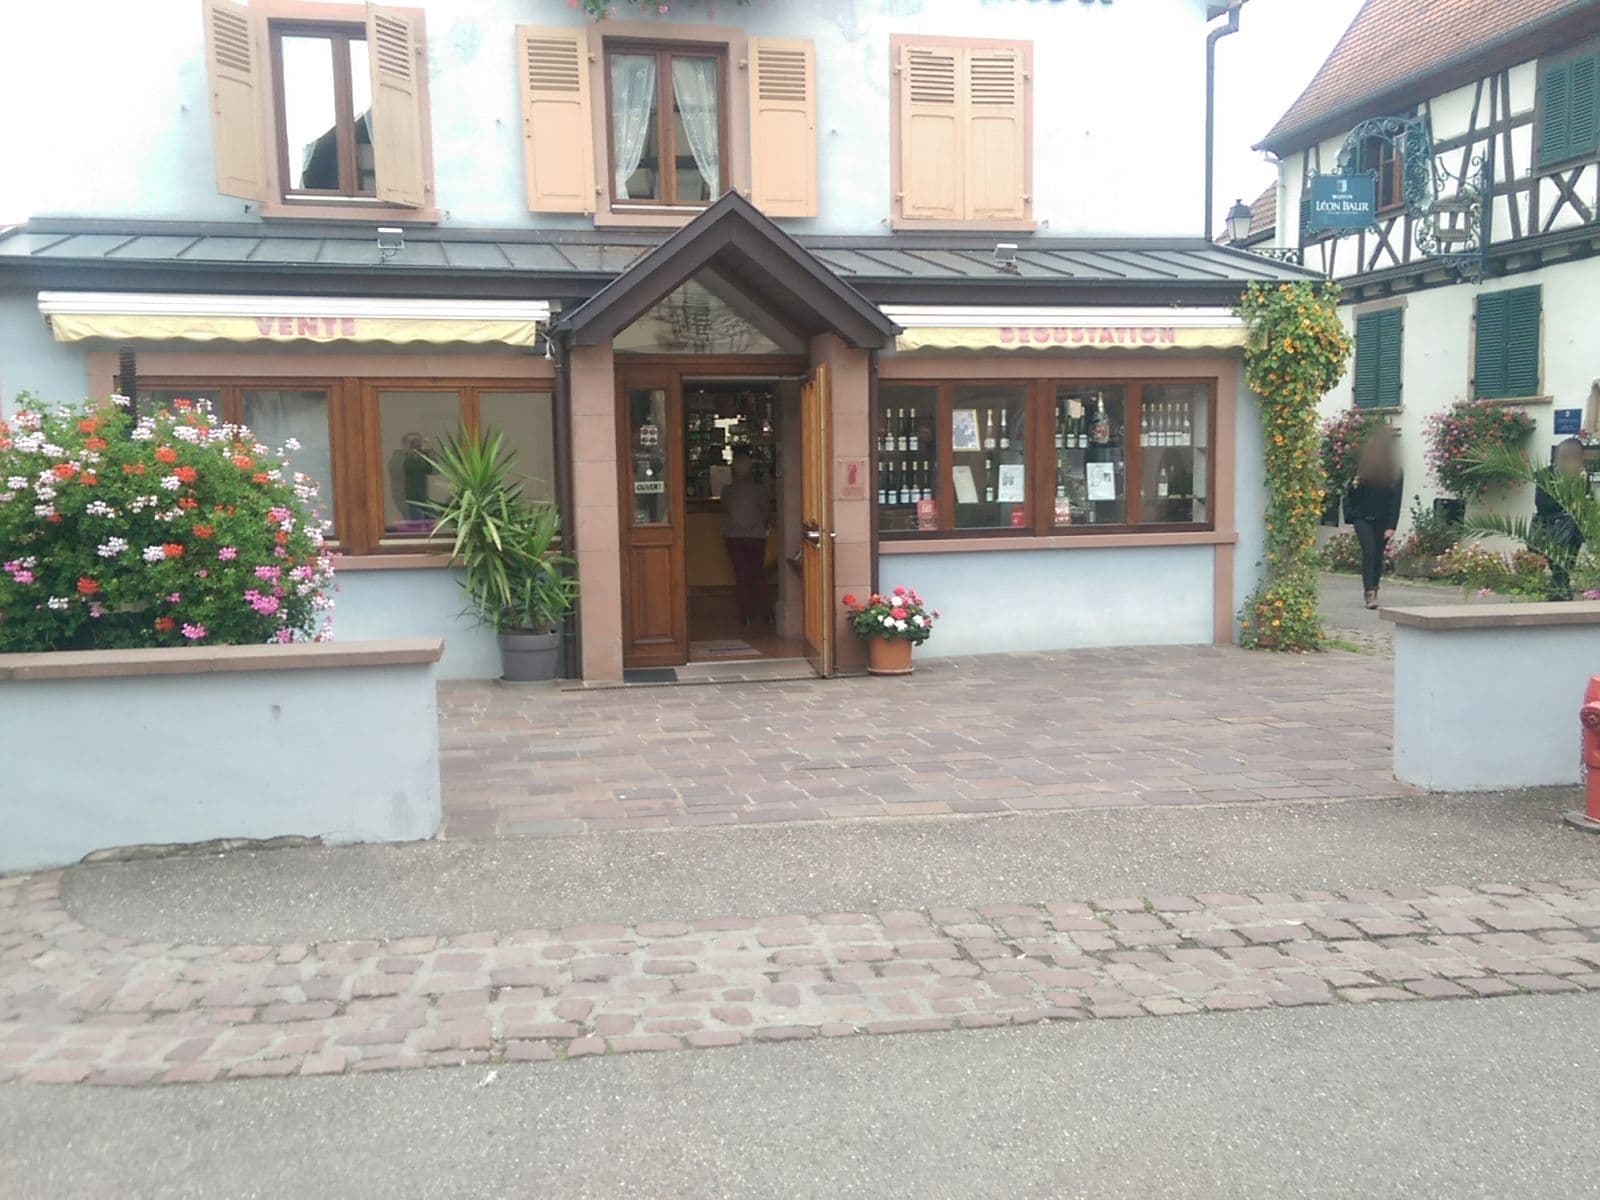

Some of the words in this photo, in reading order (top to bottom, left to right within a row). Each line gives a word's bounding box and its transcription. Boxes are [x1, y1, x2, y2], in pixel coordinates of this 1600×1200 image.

[1343, 201, 1369, 211] BAUR
[256, 316, 356, 336] VENTE
[1000, 327, 1175, 343] DEGUSTATION
